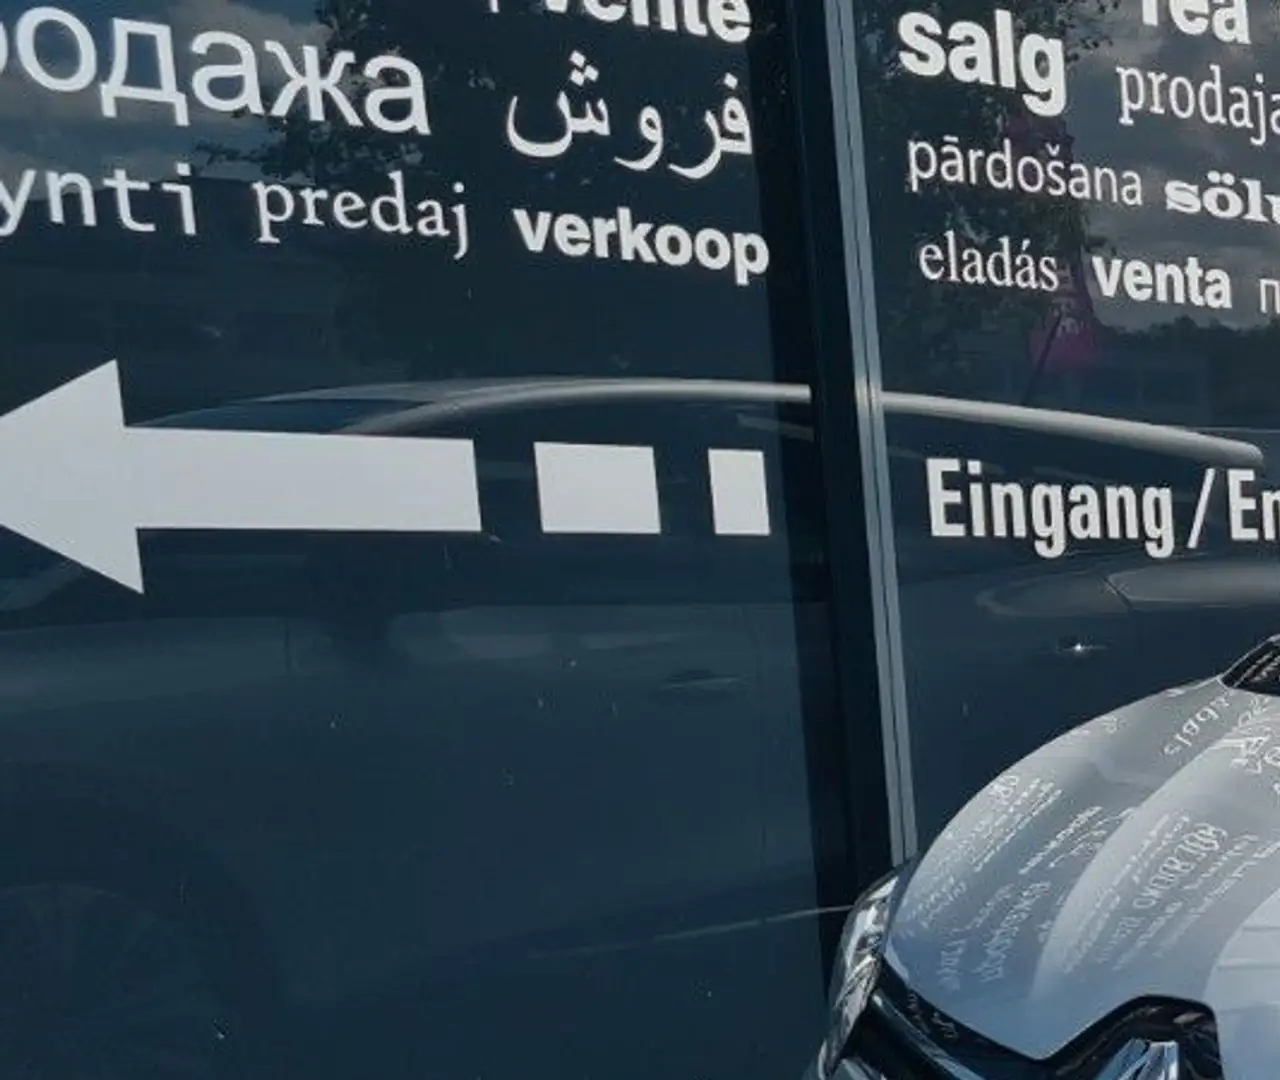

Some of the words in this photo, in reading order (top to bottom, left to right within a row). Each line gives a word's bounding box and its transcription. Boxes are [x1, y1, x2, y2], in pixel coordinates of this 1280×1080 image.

[0, 6, 432, 135] одажа
[898, 9, 1067, 117] salg
[909, 135, 1143, 206] pārdošana
[252, 171, 468, 259] predaj
[513, 207, 769, 285] verkoop
[919, 231, 1059, 292] eladás
[1091, 255, 1233, 309] venta
